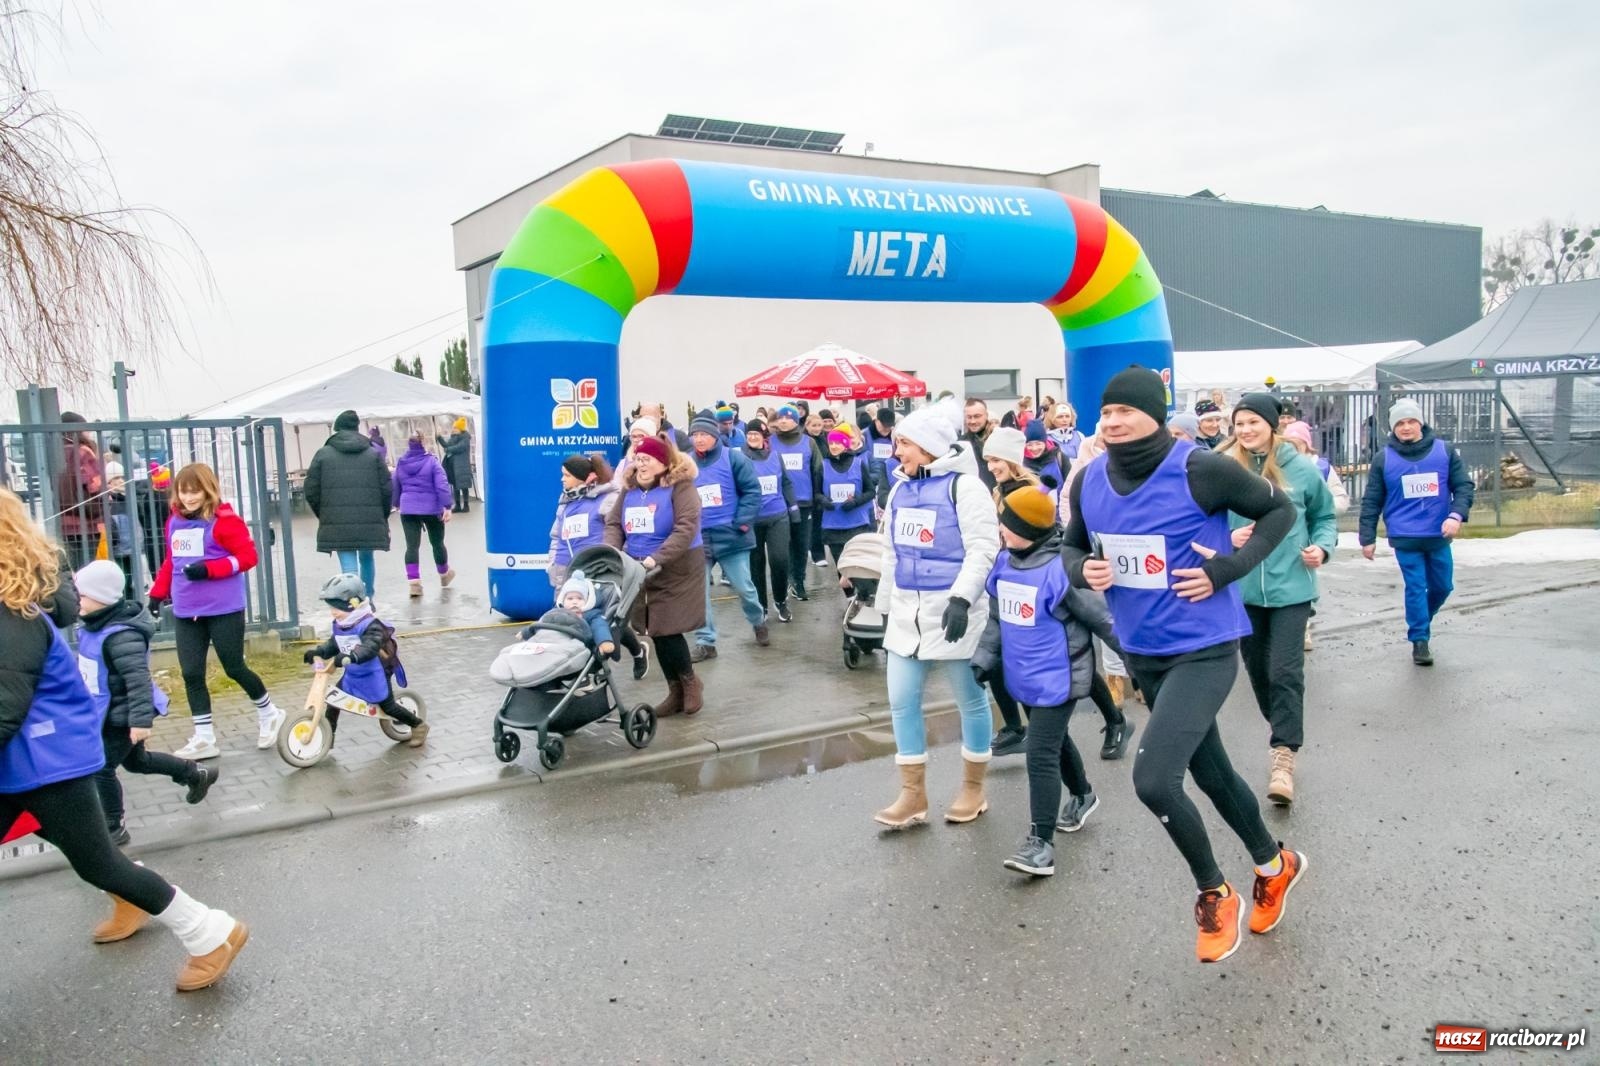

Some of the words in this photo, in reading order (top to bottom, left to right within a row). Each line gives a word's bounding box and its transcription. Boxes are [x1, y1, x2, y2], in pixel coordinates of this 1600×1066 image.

[749, 179, 843, 207] GMINA
[846, 187, 1032, 216] KRZYŻANOWICE
[846, 230, 947, 279] META
[1494, 360, 1542, 375] GMINA
[1546, 355, 1600, 373] KRZYŻ
[520, 435, 555, 447] GMINA
[1411, 482, 1429, 494] 108
[631, 517, 647, 529] 124
[901, 522, 924, 537] 107
[1117, 554, 1142, 576] 91
[1001, 597, 1021, 617] 110
